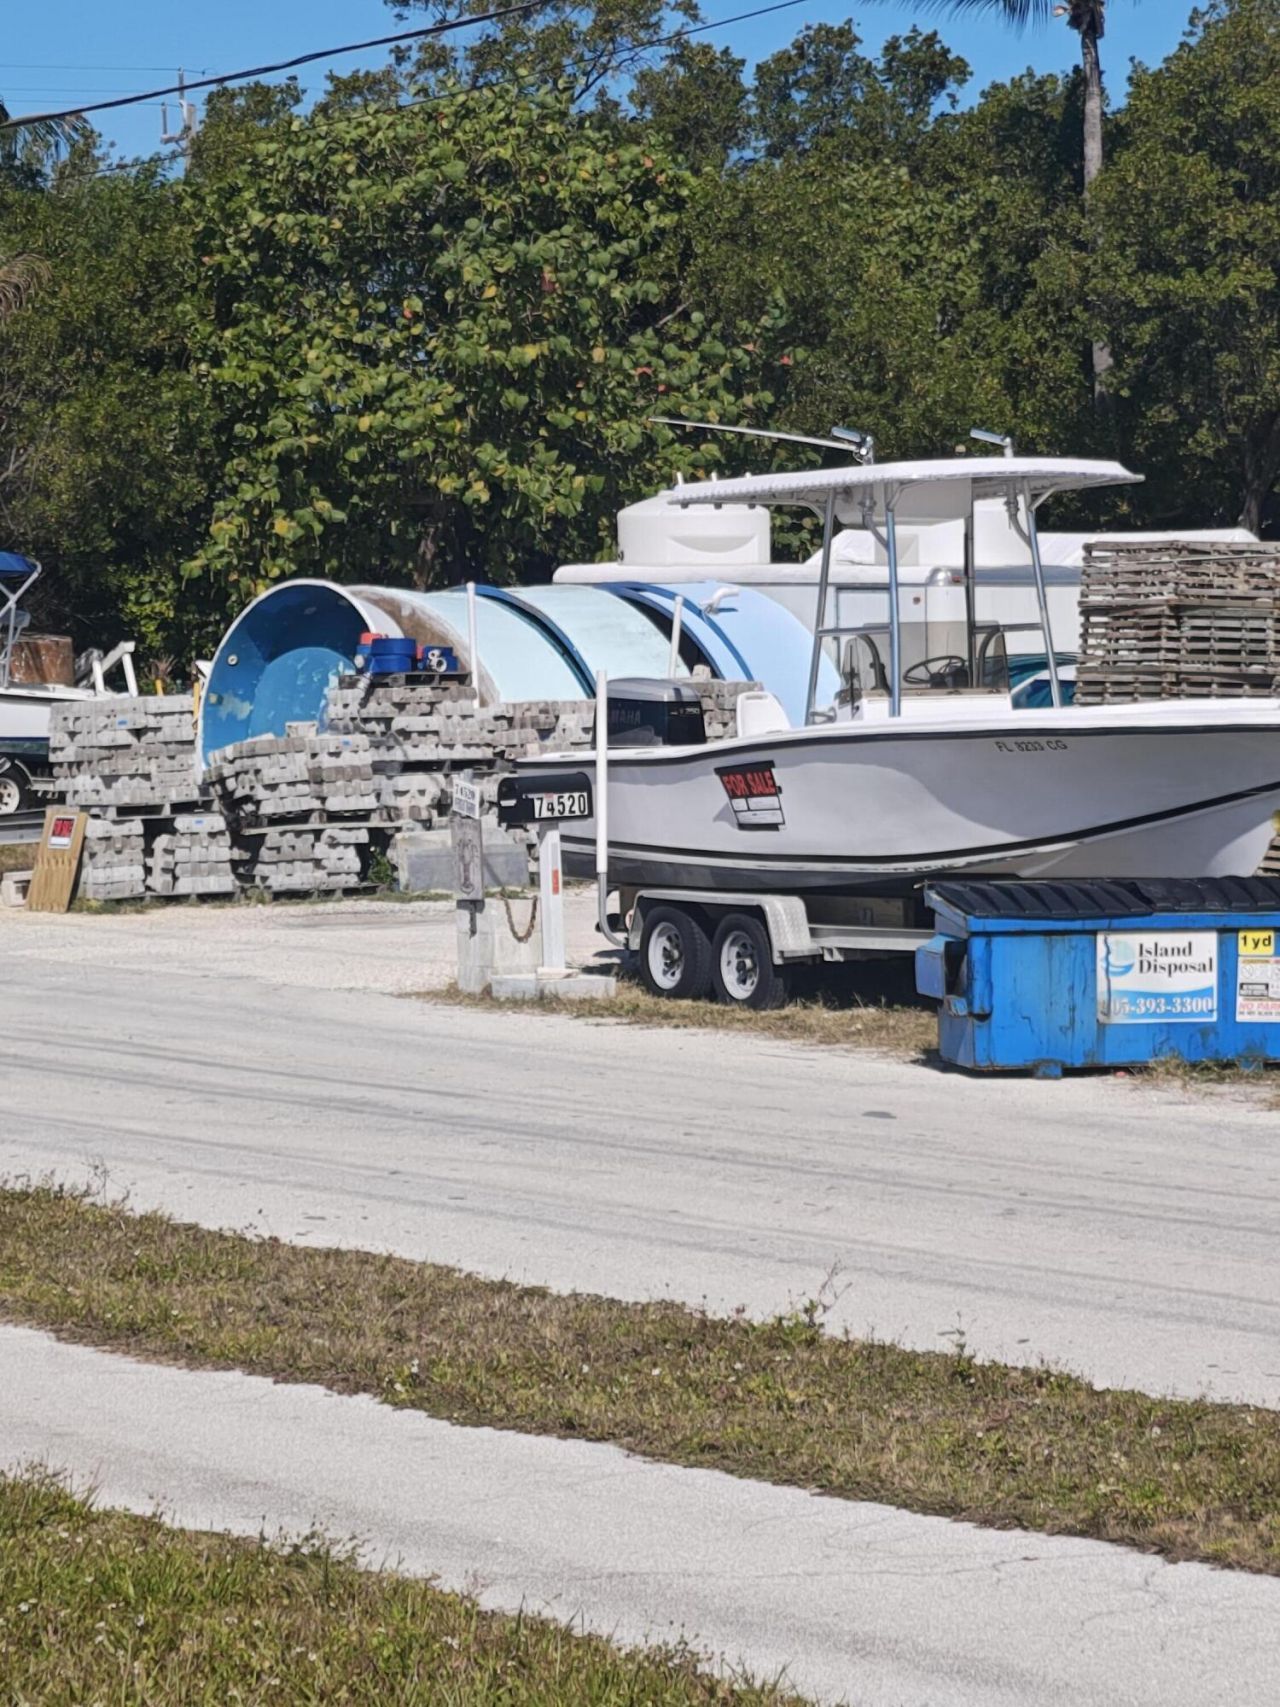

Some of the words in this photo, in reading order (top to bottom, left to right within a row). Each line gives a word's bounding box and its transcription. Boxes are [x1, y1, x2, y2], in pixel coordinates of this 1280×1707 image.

[995, 741, 1014, 752] FL
[1046, 740, 1068, 751] CG
[721, 774, 749, 797] FOR
[746, 769, 776, 795] SALE
[535, 794, 587, 817] 74520
[1138, 942, 1192, 957] Island
[1241, 935, 1247, 947] 1
[1252, 935, 1272, 950] yd
[1138, 957, 1213, 977] Disposal
